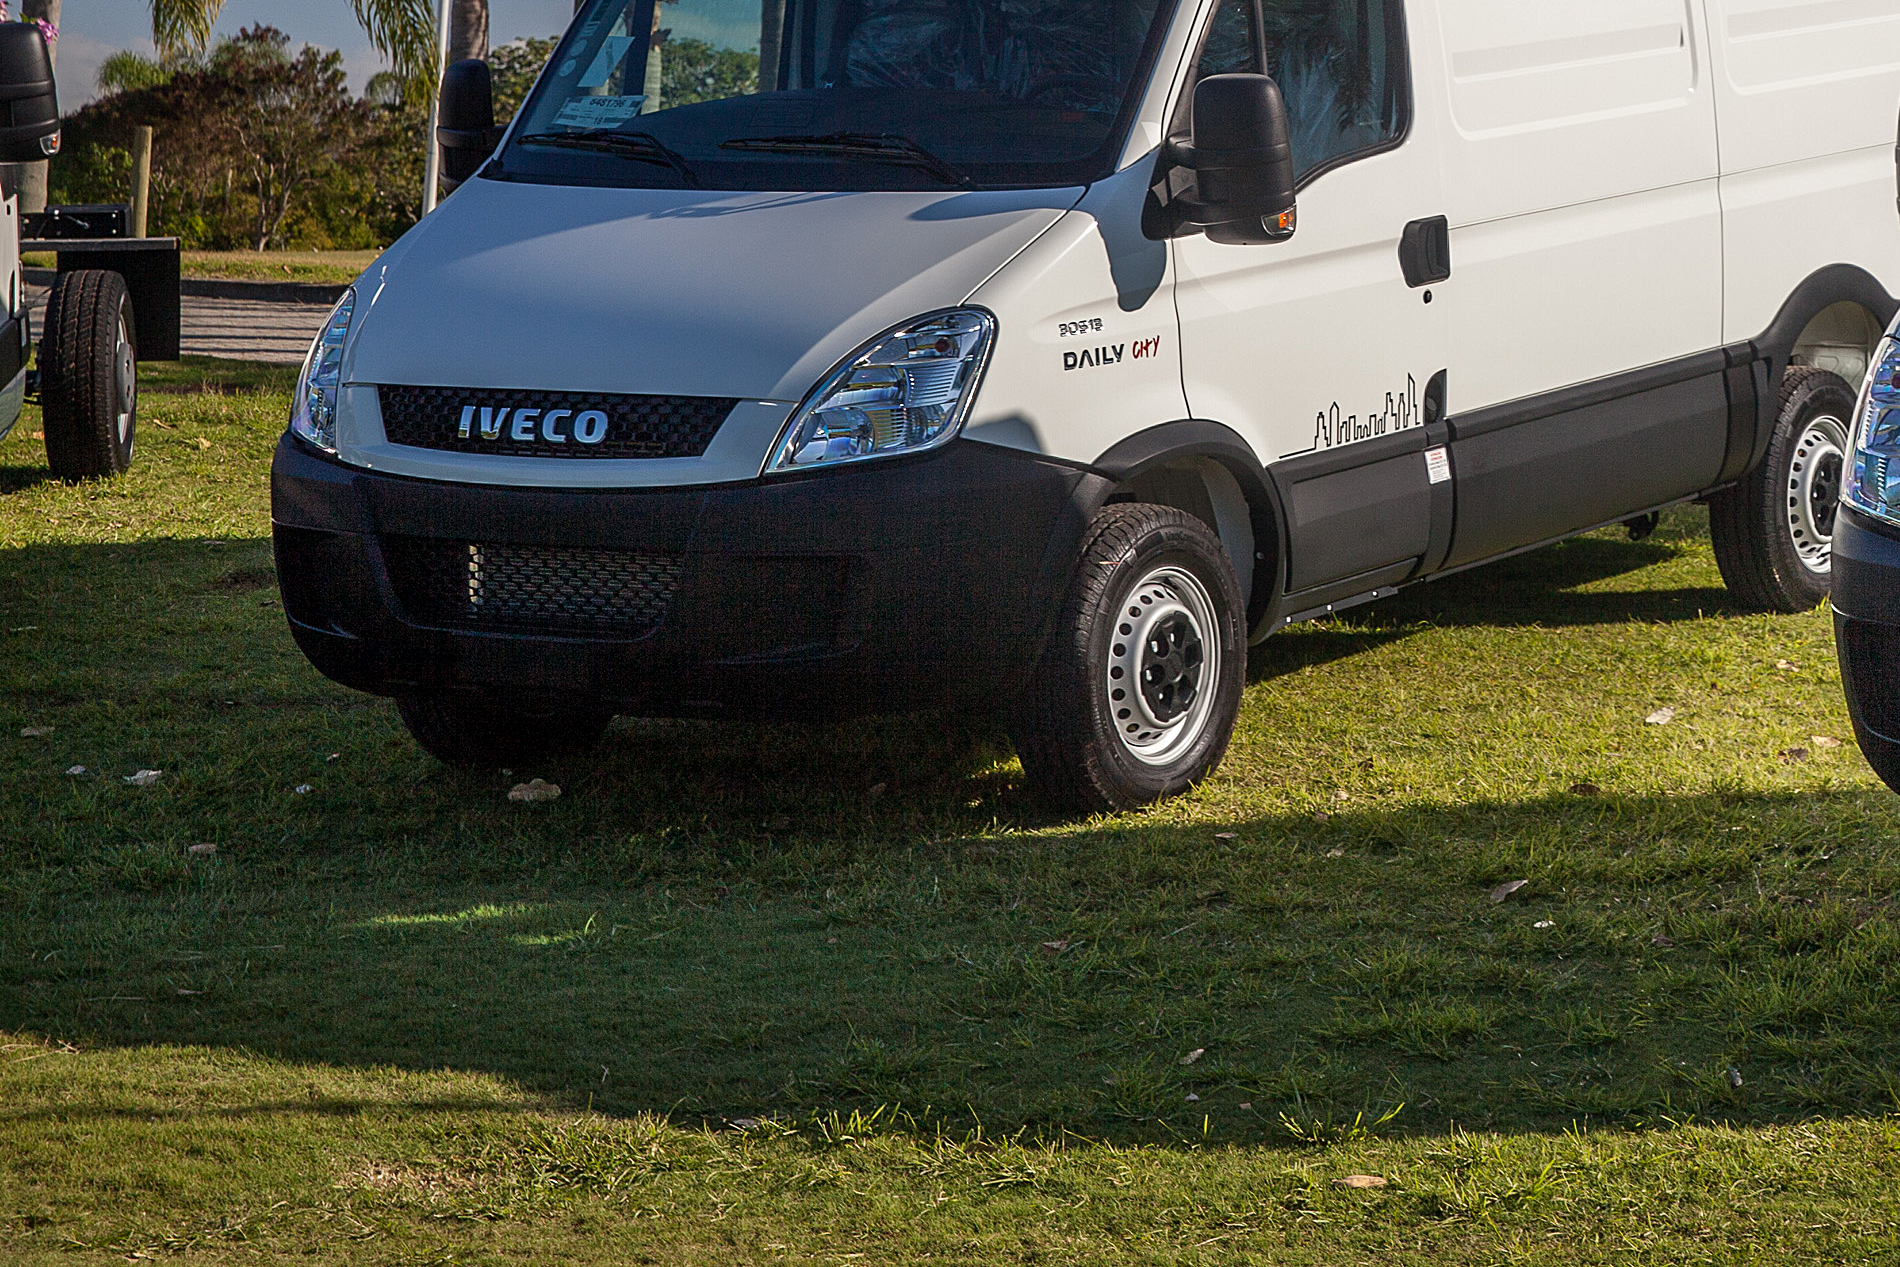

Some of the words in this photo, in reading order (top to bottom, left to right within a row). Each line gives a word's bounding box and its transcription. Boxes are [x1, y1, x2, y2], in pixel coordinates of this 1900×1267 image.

[1063, 343, 1125, 371] DAILY
[1131, 335, 1161, 359] CITY
[457, 405, 609, 444] IVECO
